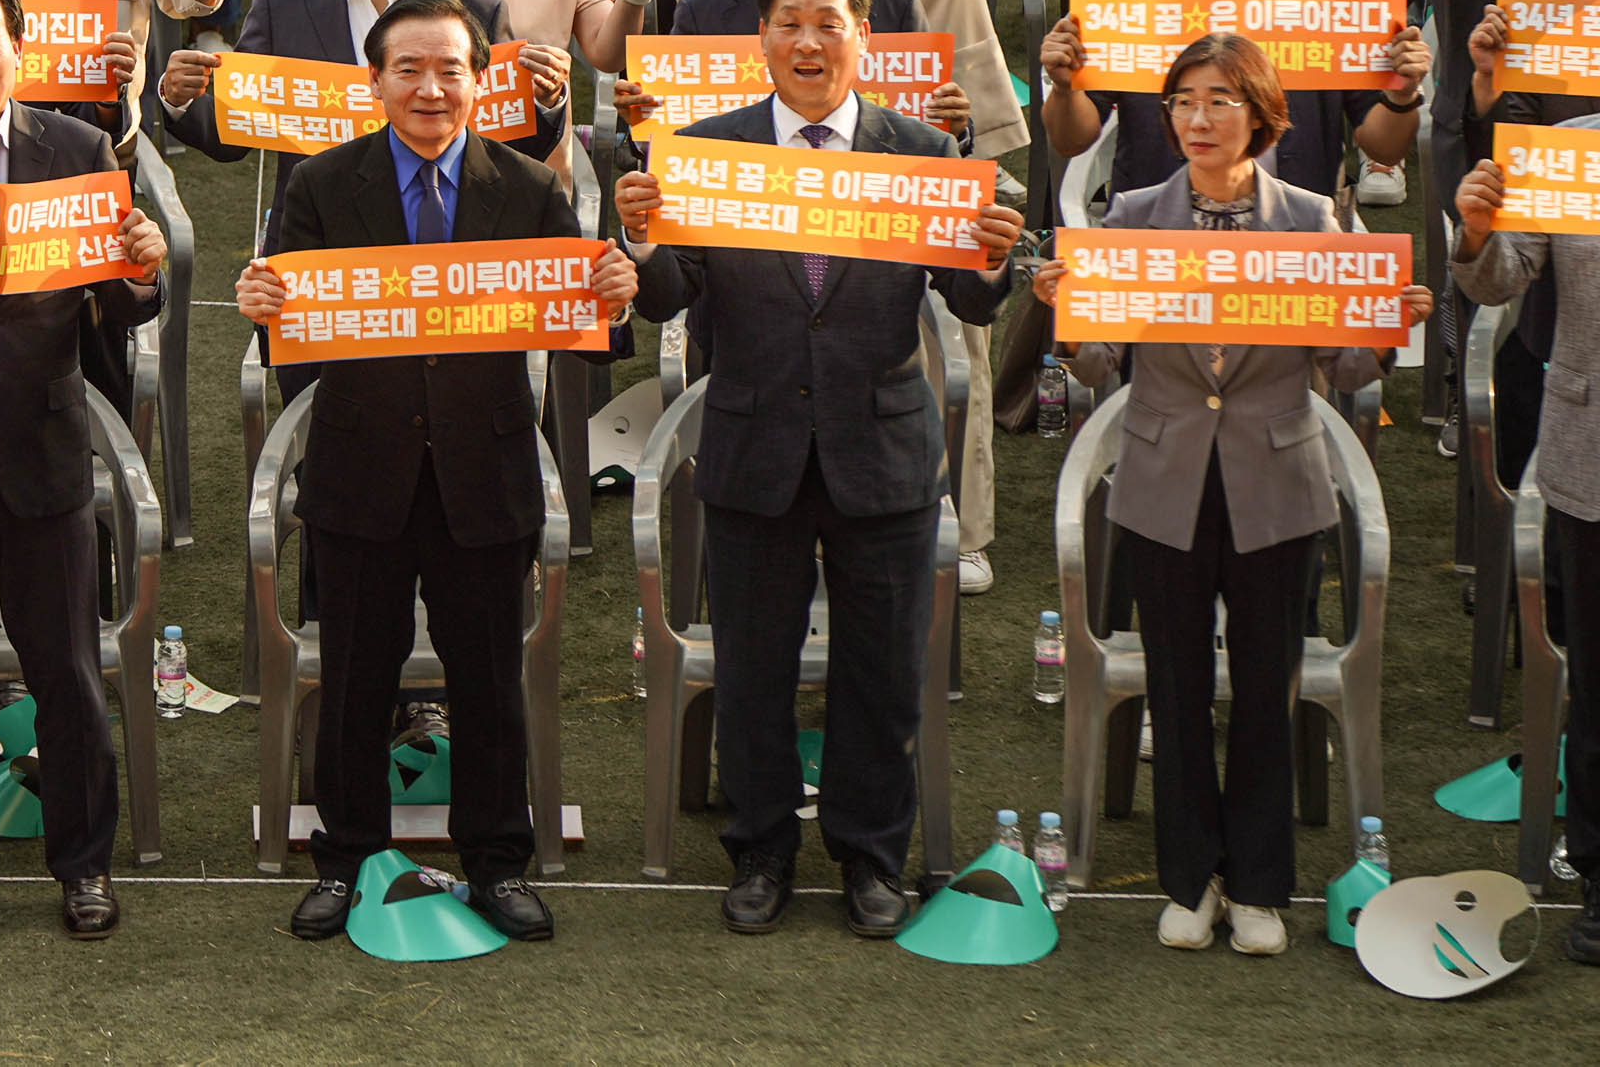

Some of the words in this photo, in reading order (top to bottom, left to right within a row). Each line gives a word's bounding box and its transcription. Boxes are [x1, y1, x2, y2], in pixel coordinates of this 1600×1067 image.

[1084, 2, 1147, 35] 34년
[1246, 0, 1393, 34] 이루어진다
[664, 155, 729, 190] 34년
[832, 169, 983, 210] 이루어진다
[7, 191, 120, 235] 이루어진다
[660, 193, 799, 235] 국립목포대
[805, 206, 921, 244] 의과대학
[281, 268, 344, 301] 34년
[446, 256, 593, 295] 이루어진다
[1071, 247, 1138, 281] 34년
[1244, 249, 1399, 286] 이루어진다
[279, 307, 417, 343] 국립목포대
[425, 301, 537, 336] 의과대학
[543, 299, 599, 332] 신설
[1068, 290, 1213, 325] 국립목포대
[1220, 293, 1339, 327] 의과대학
[1343, 295, 1401, 328] 신설
